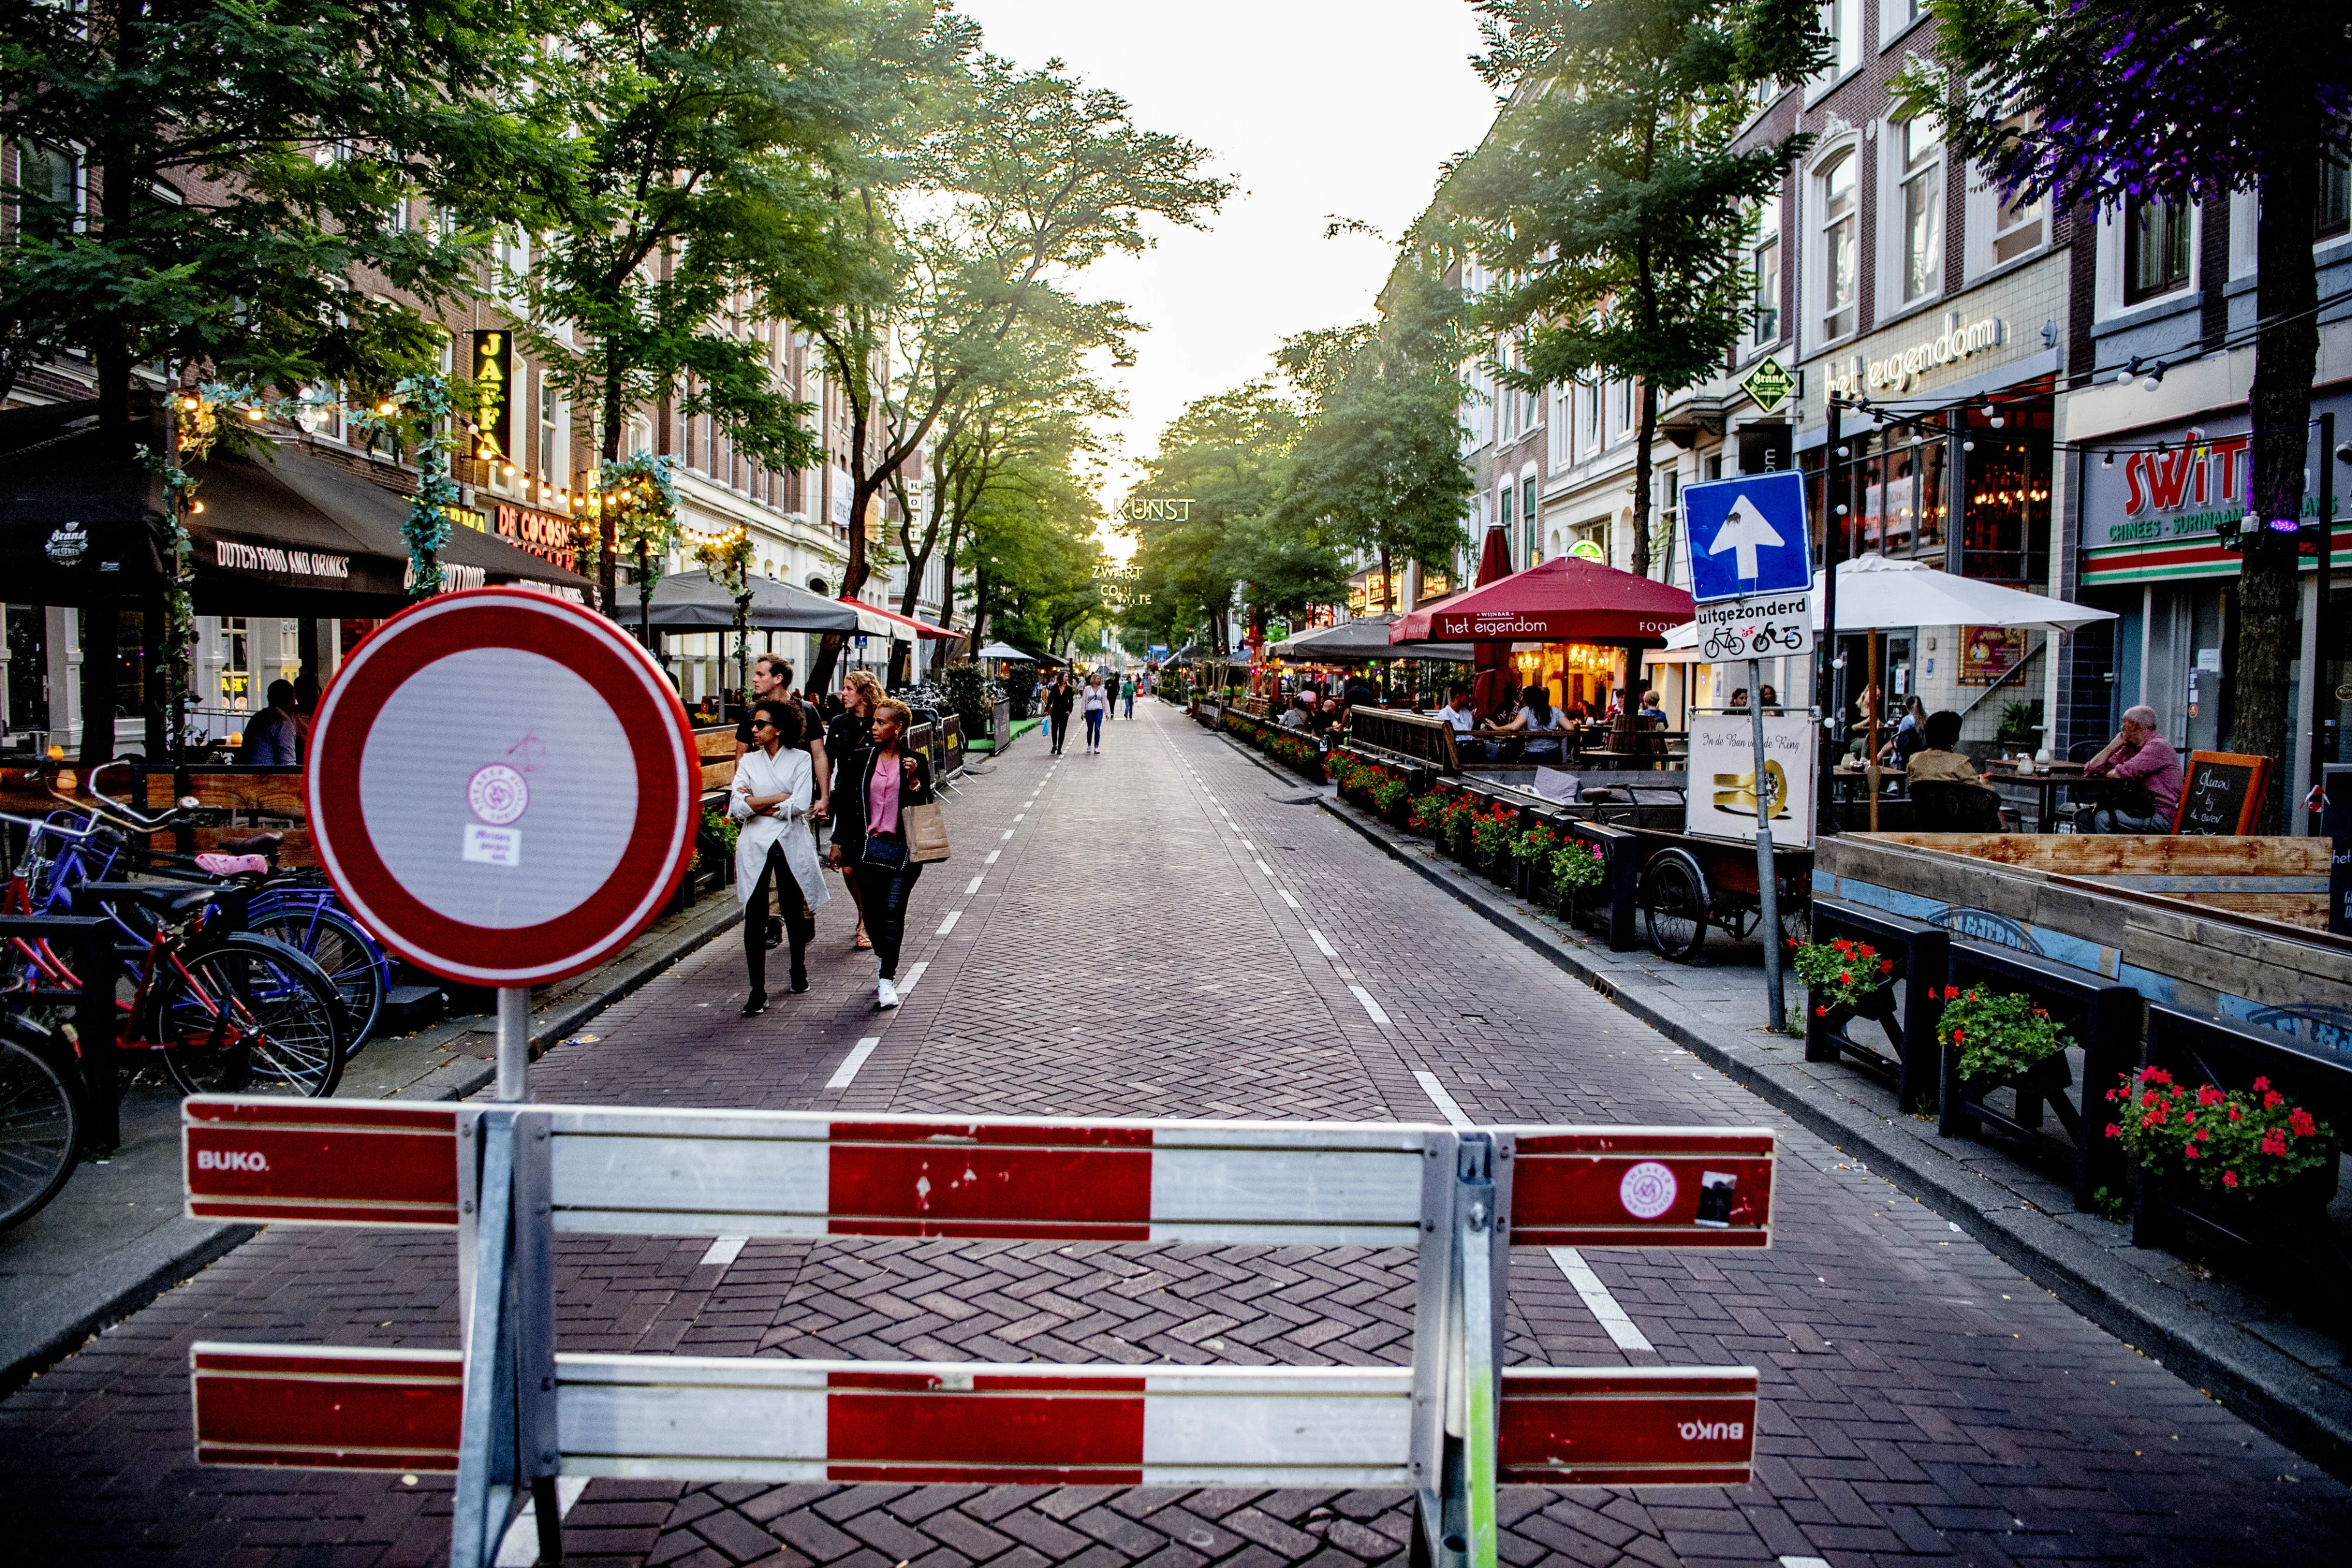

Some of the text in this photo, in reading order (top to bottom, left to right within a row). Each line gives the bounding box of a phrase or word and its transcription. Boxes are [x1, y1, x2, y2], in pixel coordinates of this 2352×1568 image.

[1825, 312, 1998, 404] het eigendom
[1753, 372, 1787, 385] Brand
[1114, 499, 1196, 520] KUNST
[499, 505, 576, 549] DE COCOSN
[2109, 507, 2247, 541] CHINEES SURINAAM
[51, 529, 87, 541] Brand
[216, 541, 350, 578] DUTCH FOOD AND DRINKS
[1092, 565, 1144, 579] ZWART
[1698, 598, 1806, 625] uitgezonderd
[1446, 617, 1469, 634] het
[1474, 616, 1547, 636] eigendom
[1640, 622, 1678, 632] FOOD
[1703, 733, 1713, 746] In
[1715, 734, 1724, 746] de
[1726, 733, 1746, 747] Ban
[1764, 736, 1774, 749] de
[1775, 734, 1800, 755] Ring
[2332, 849, 2351, 864] het
